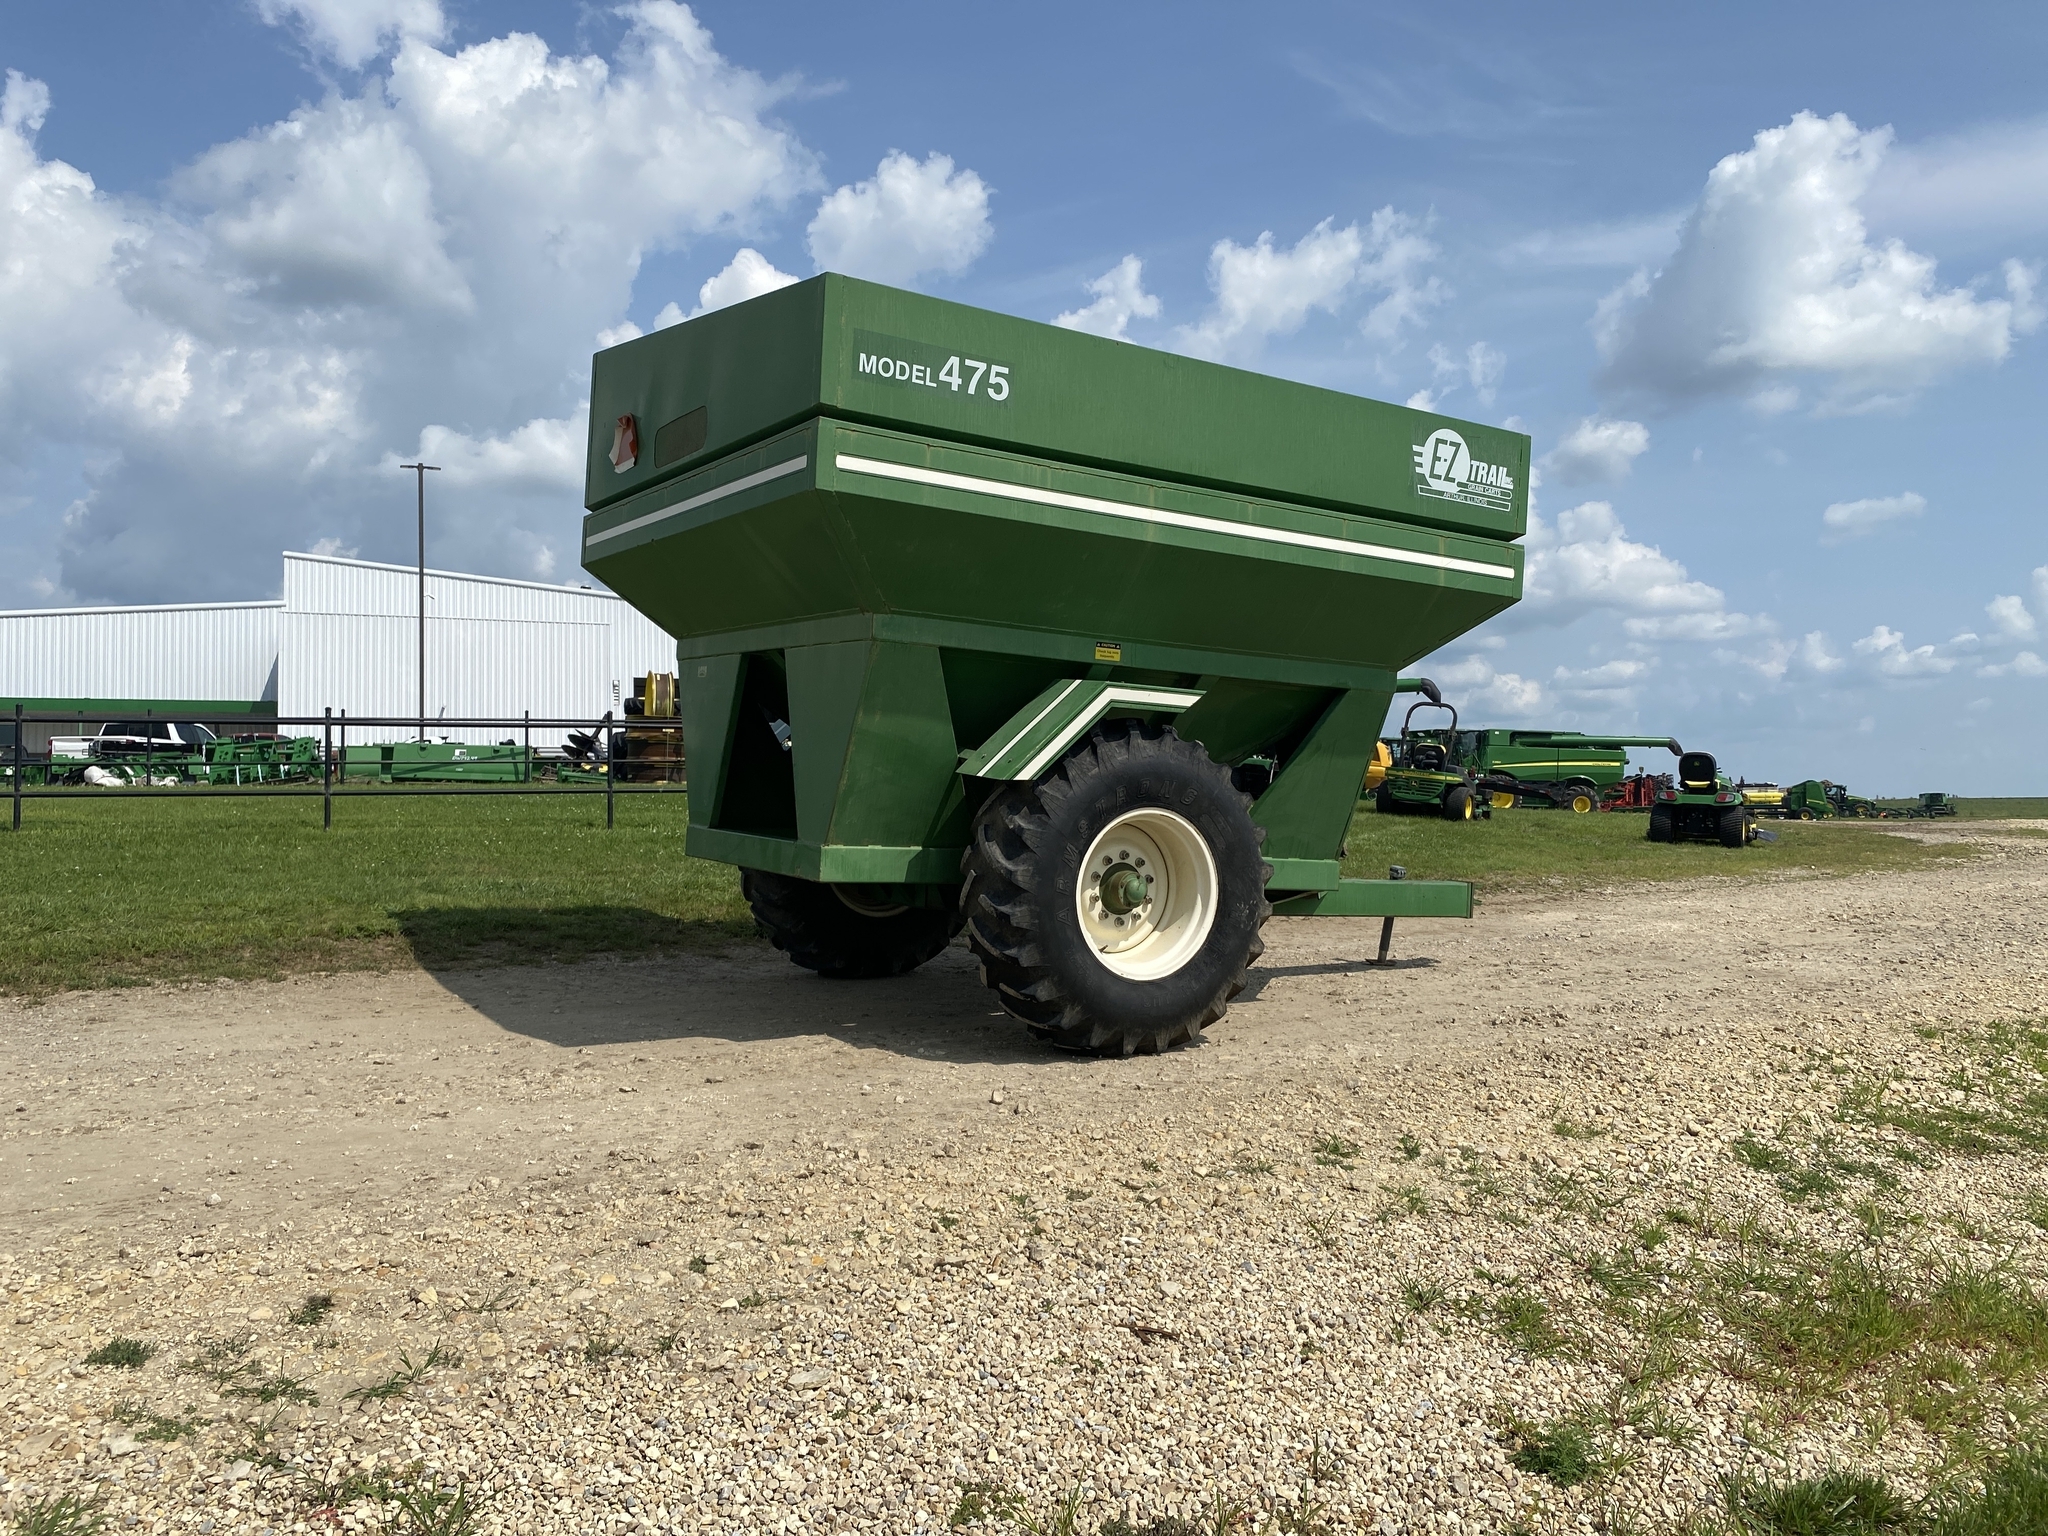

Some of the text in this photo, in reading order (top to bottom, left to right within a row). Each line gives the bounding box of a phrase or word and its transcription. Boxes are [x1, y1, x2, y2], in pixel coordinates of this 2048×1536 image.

[858, 352, 1010, 401] MODEL 475
[1470, 460, 1513, 489] TRAIL
[1055, 777, 1198, 927] ARMSTRONG
